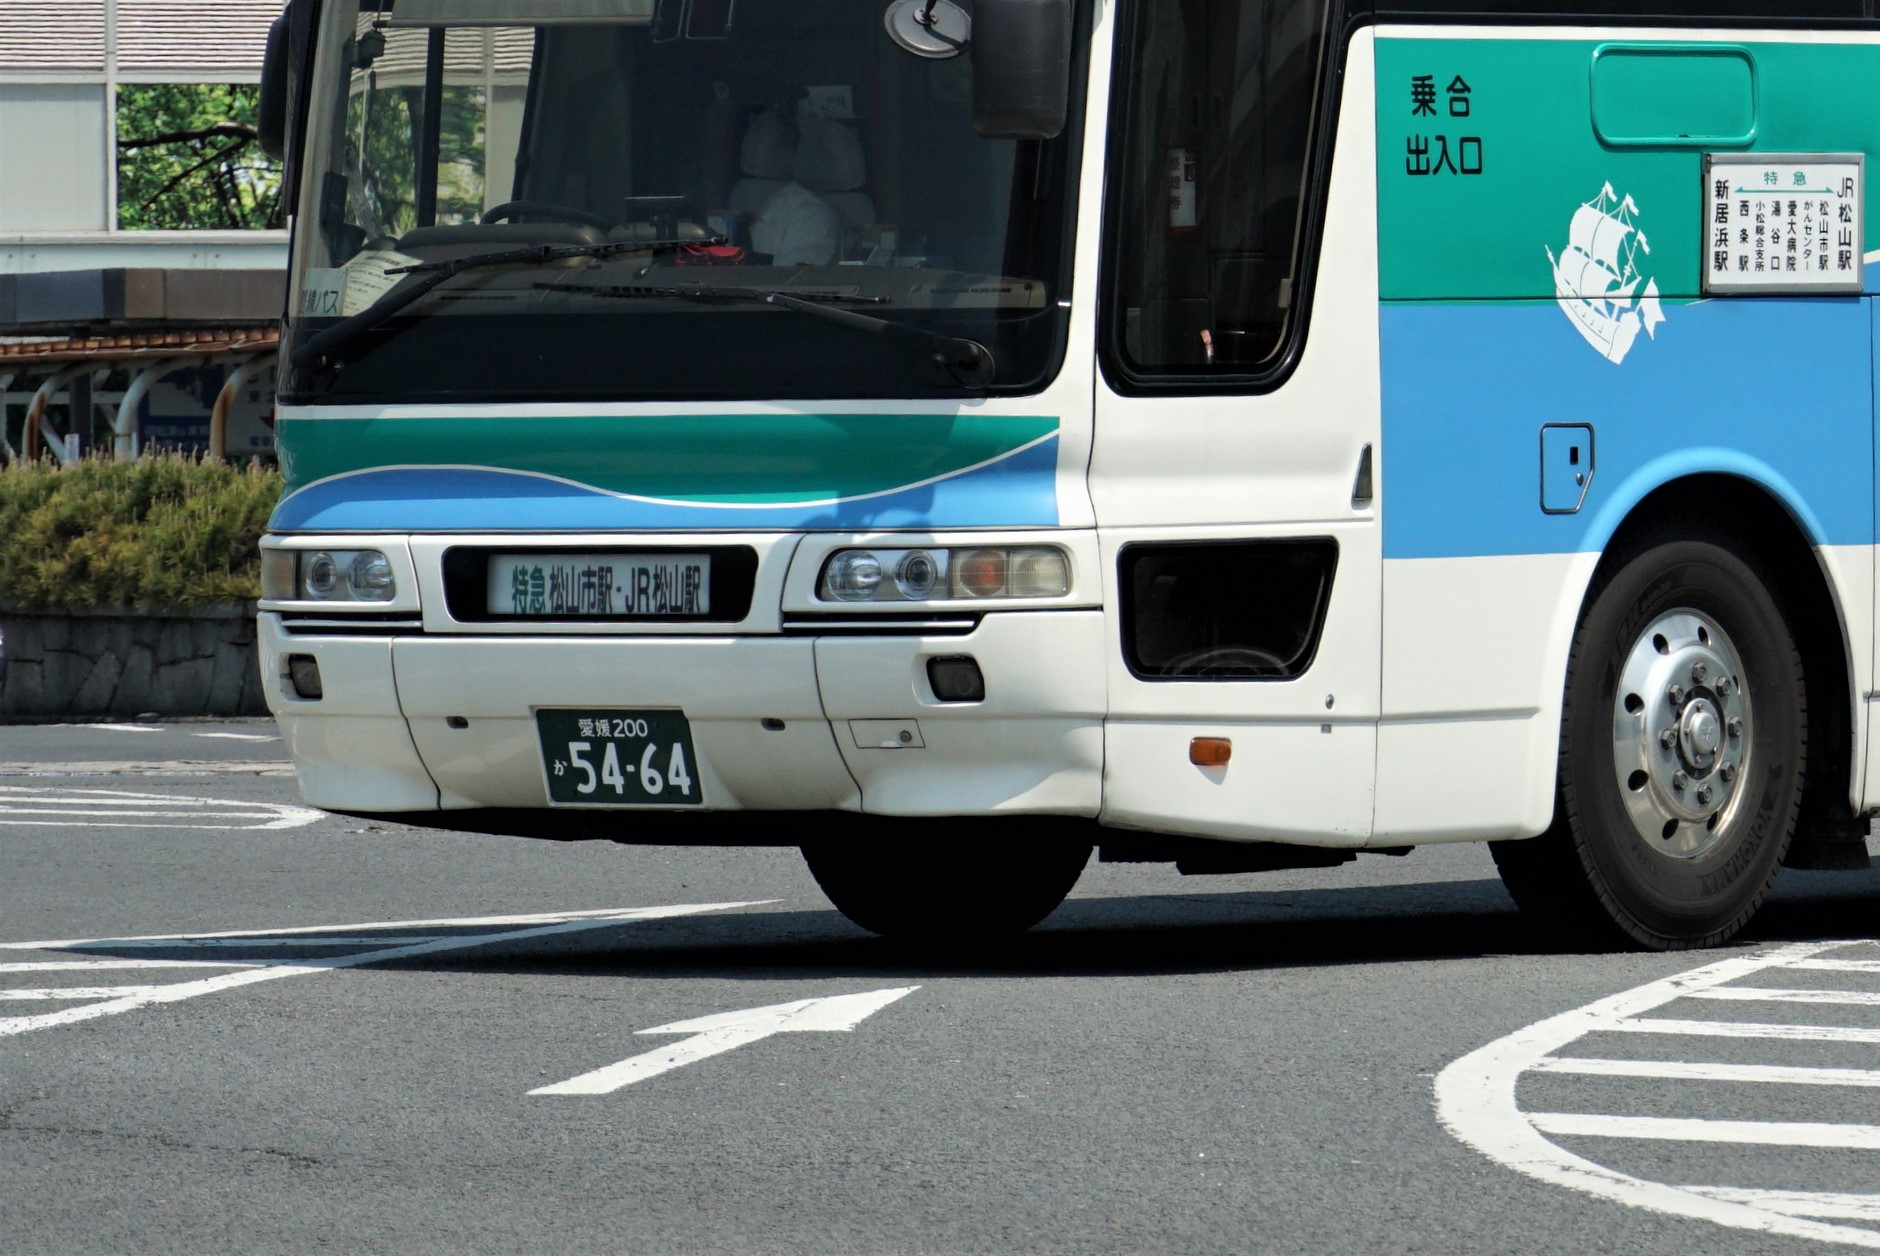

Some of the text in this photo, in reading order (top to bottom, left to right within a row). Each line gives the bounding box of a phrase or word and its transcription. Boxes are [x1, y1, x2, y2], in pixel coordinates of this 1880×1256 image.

[1410, 74, 1472, 117] 乗合
[1406, 133, 1483, 175] 出入口
[1763, 171, 1807, 186] 特急
[1713, 179, 1730, 272] 新居浜駅
[1738, 200, 1750, 272] 西条駅
[1755, 200, 1766, 273] 小松総合支所
[1770, 200, 1781, 271] 湯谷口
[1786, 200, 1797, 272] 愛大病院
[1803, 200, 1813, 271] がんセンター
[1818, 200, 1829, 272] 松山市駅
[1836, 177, 1854, 271] JR松山駅
[512, 565, 546, 614] 特急
[553, 741, 692, 796] か 54-64
